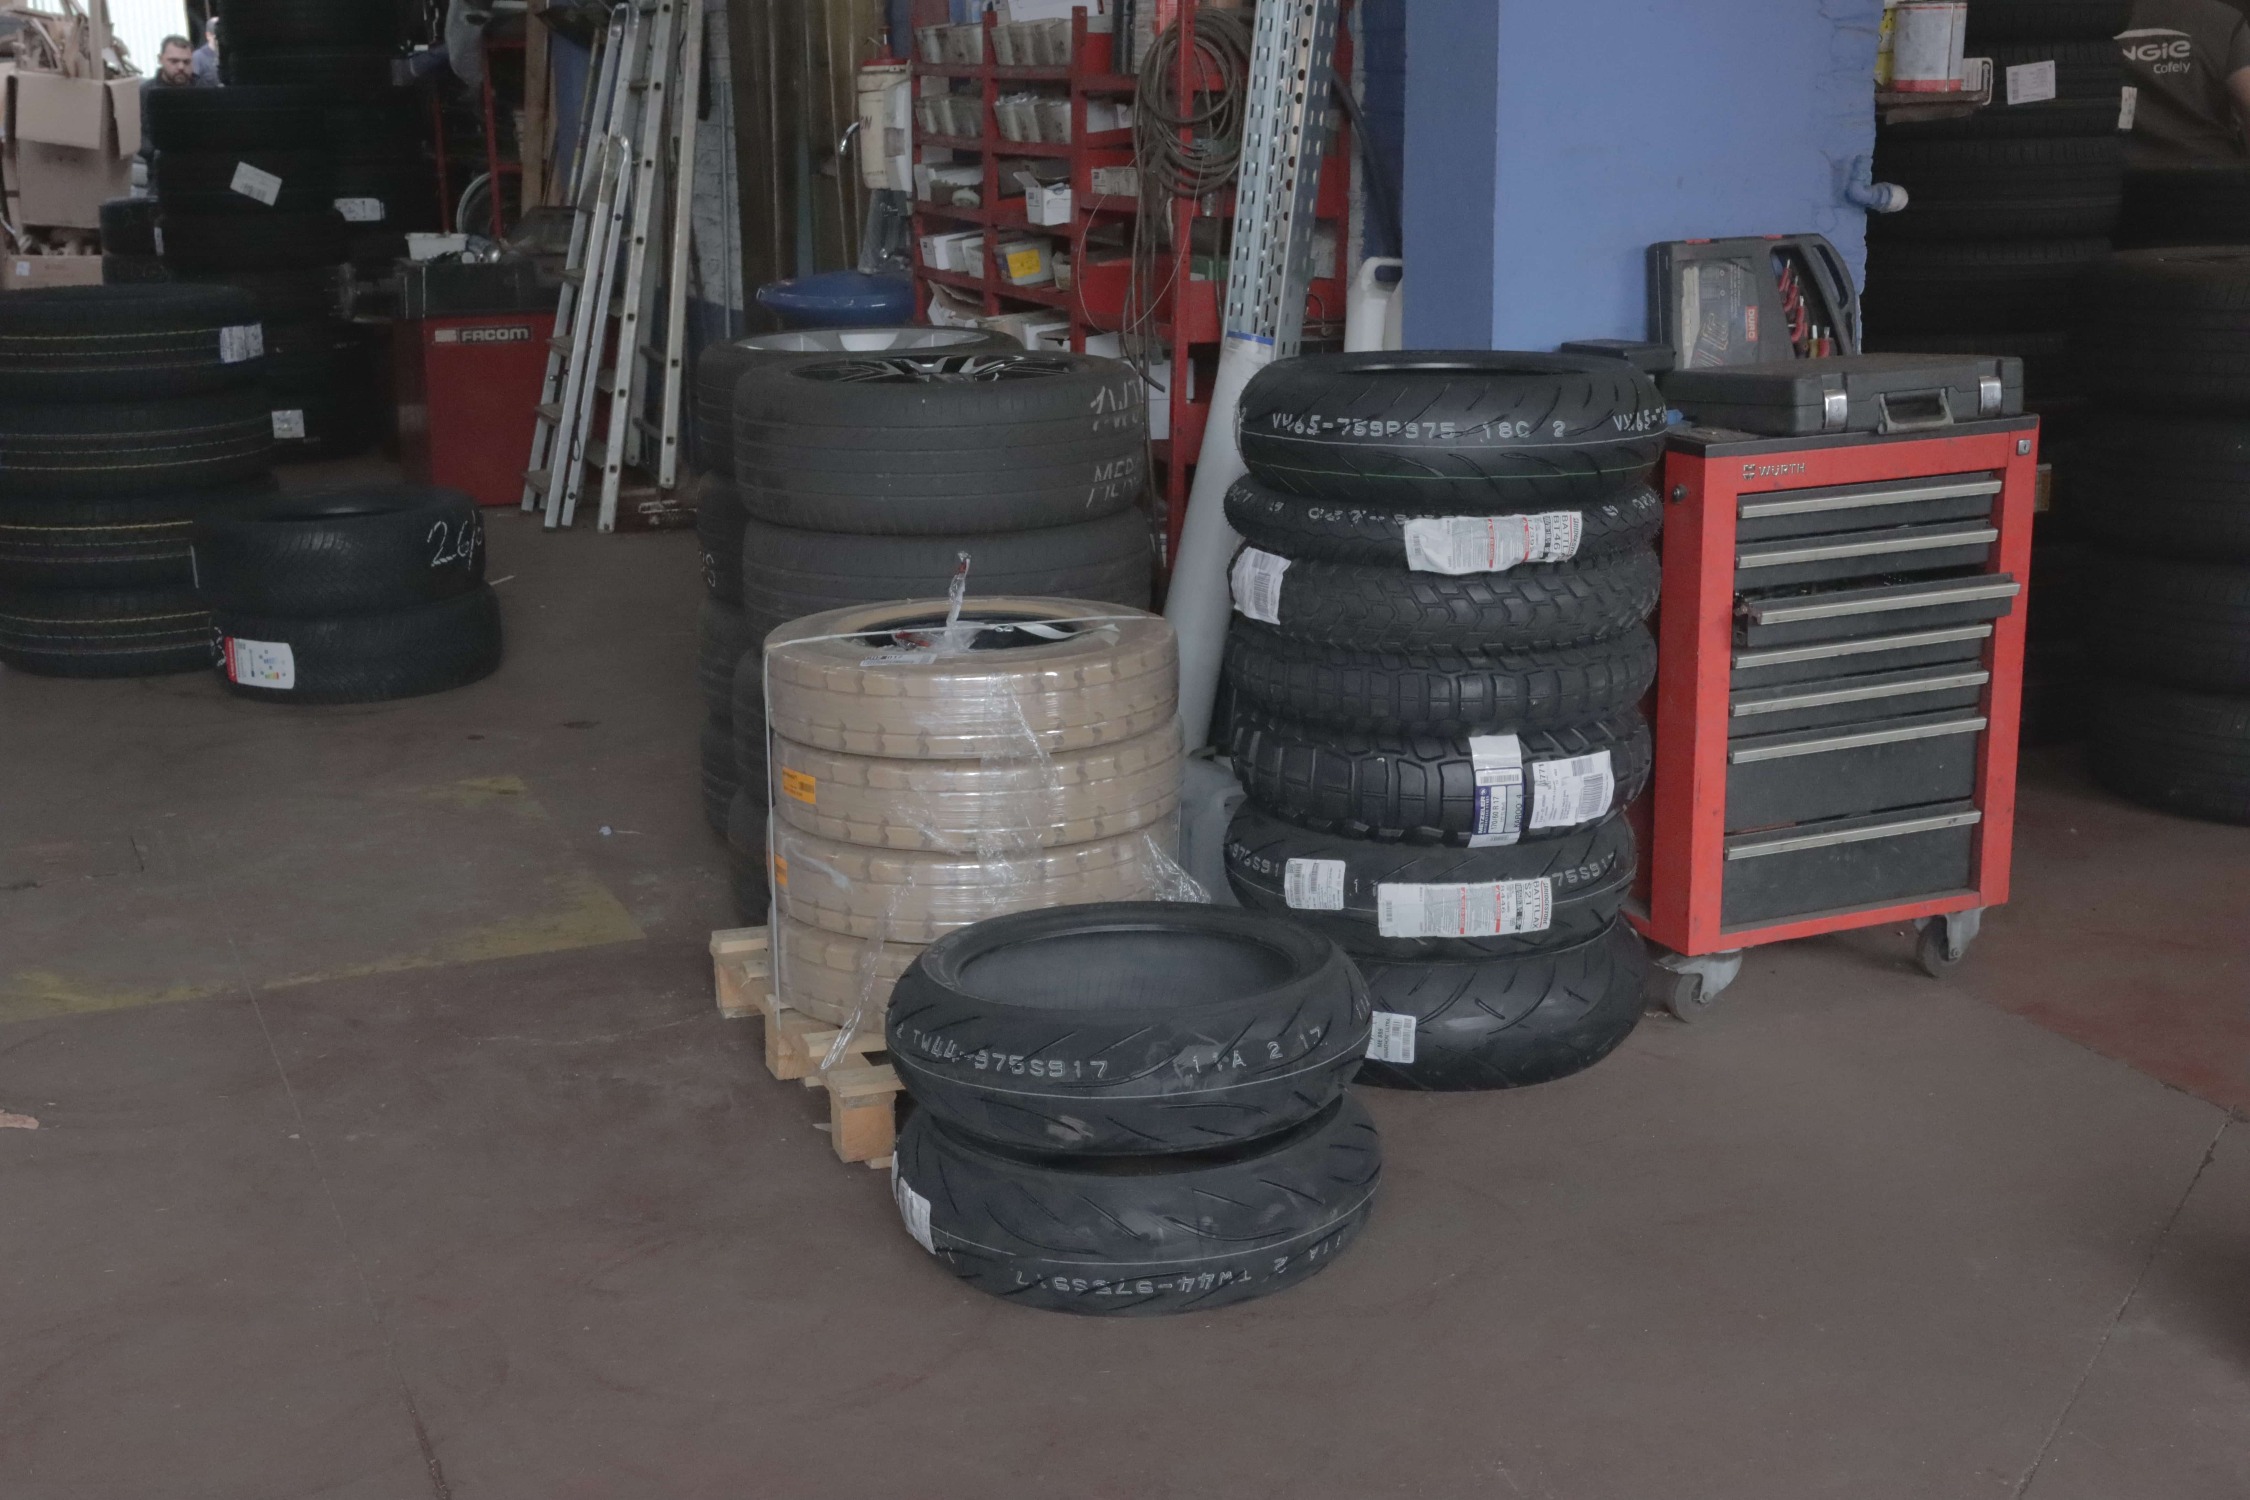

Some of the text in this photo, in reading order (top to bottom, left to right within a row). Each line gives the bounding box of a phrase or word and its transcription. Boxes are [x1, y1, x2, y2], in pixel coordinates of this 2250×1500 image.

[2152, 60, 2191, 74] Cofely
[462, 328, 529, 341] FACOM
[1553, 420, 1567, 438] 2
[1553, 515, 1561, 551] BT46
[1477, 795, 1486, 834] METZELER
[1524, 882, 1533, 905] S21
[1532, 880, 1541, 929] BATTLAX
[1267, 1041, 1284, 1060] 2
